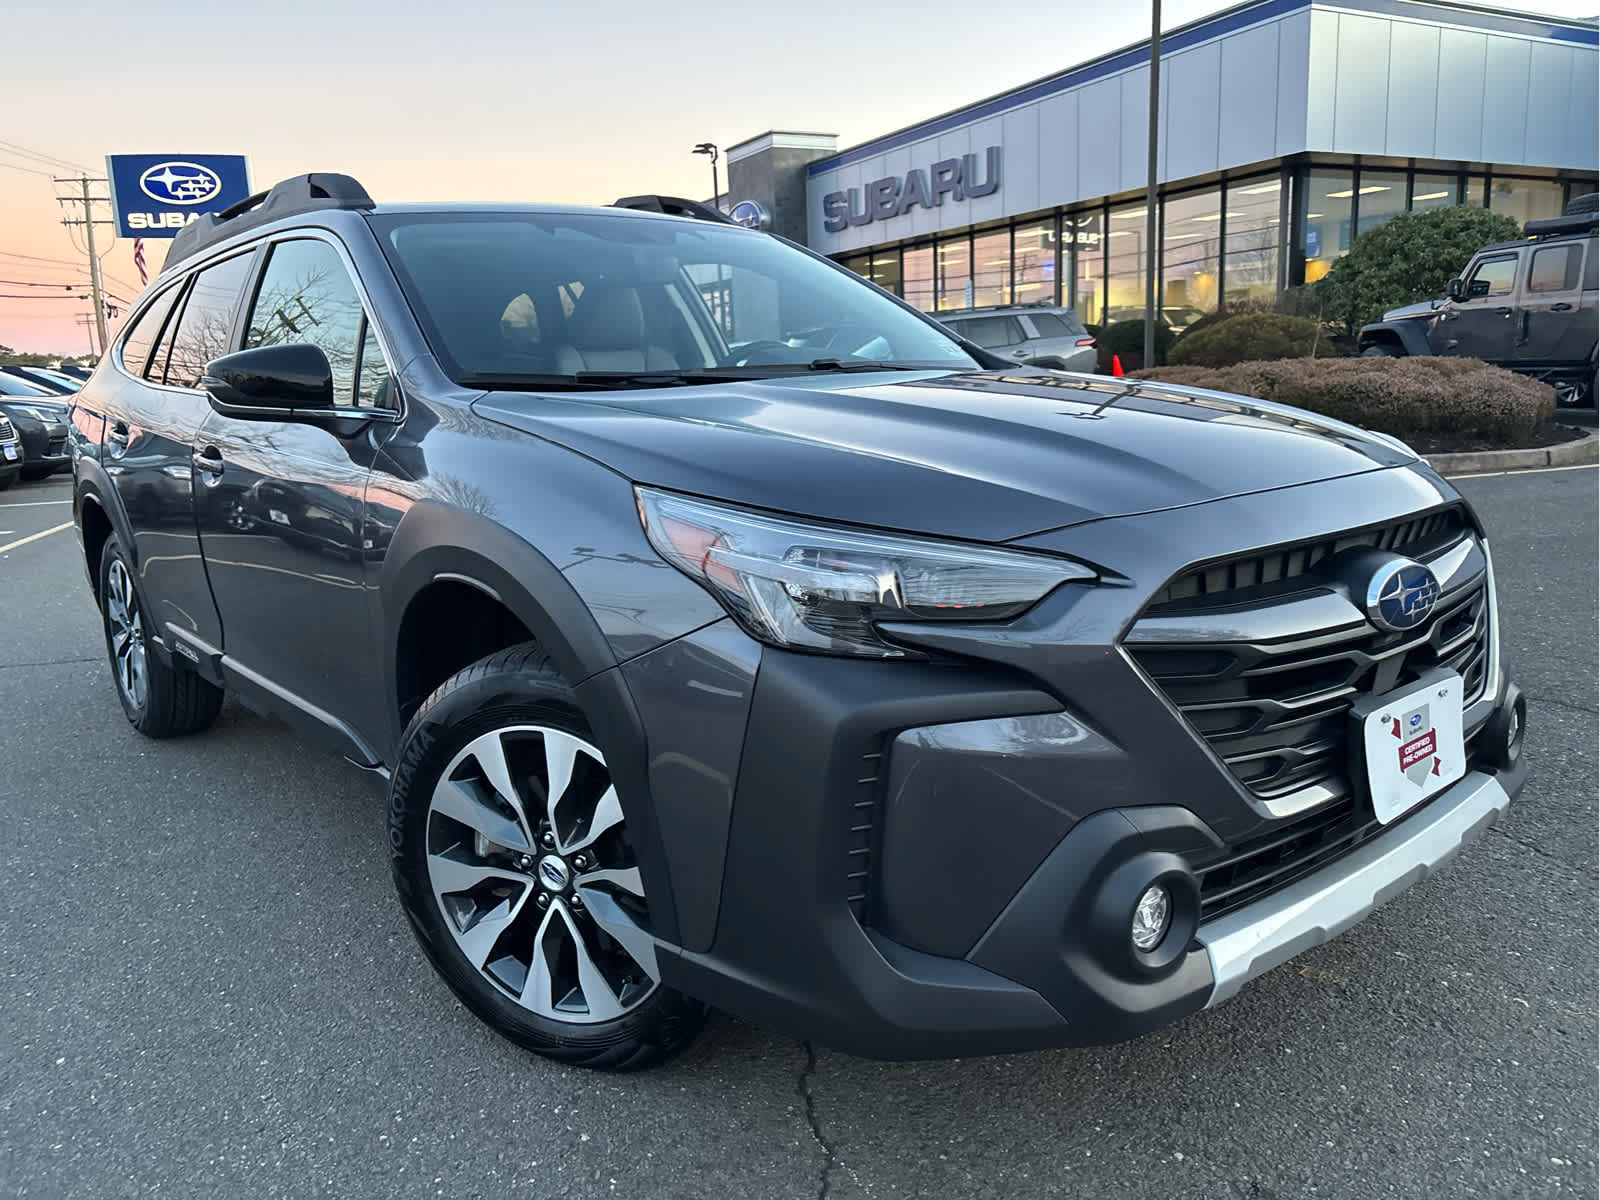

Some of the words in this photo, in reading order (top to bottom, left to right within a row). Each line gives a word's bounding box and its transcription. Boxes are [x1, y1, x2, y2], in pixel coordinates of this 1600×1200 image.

[823, 146, 1002, 233] SUBARU
[127, 212, 221, 229] SUBA
[1403, 744, 1433, 766] PRE-OWNED
[1404, 736, 1431, 755] CERTIFIED
[390, 721, 434, 858] YOKOHAMA
